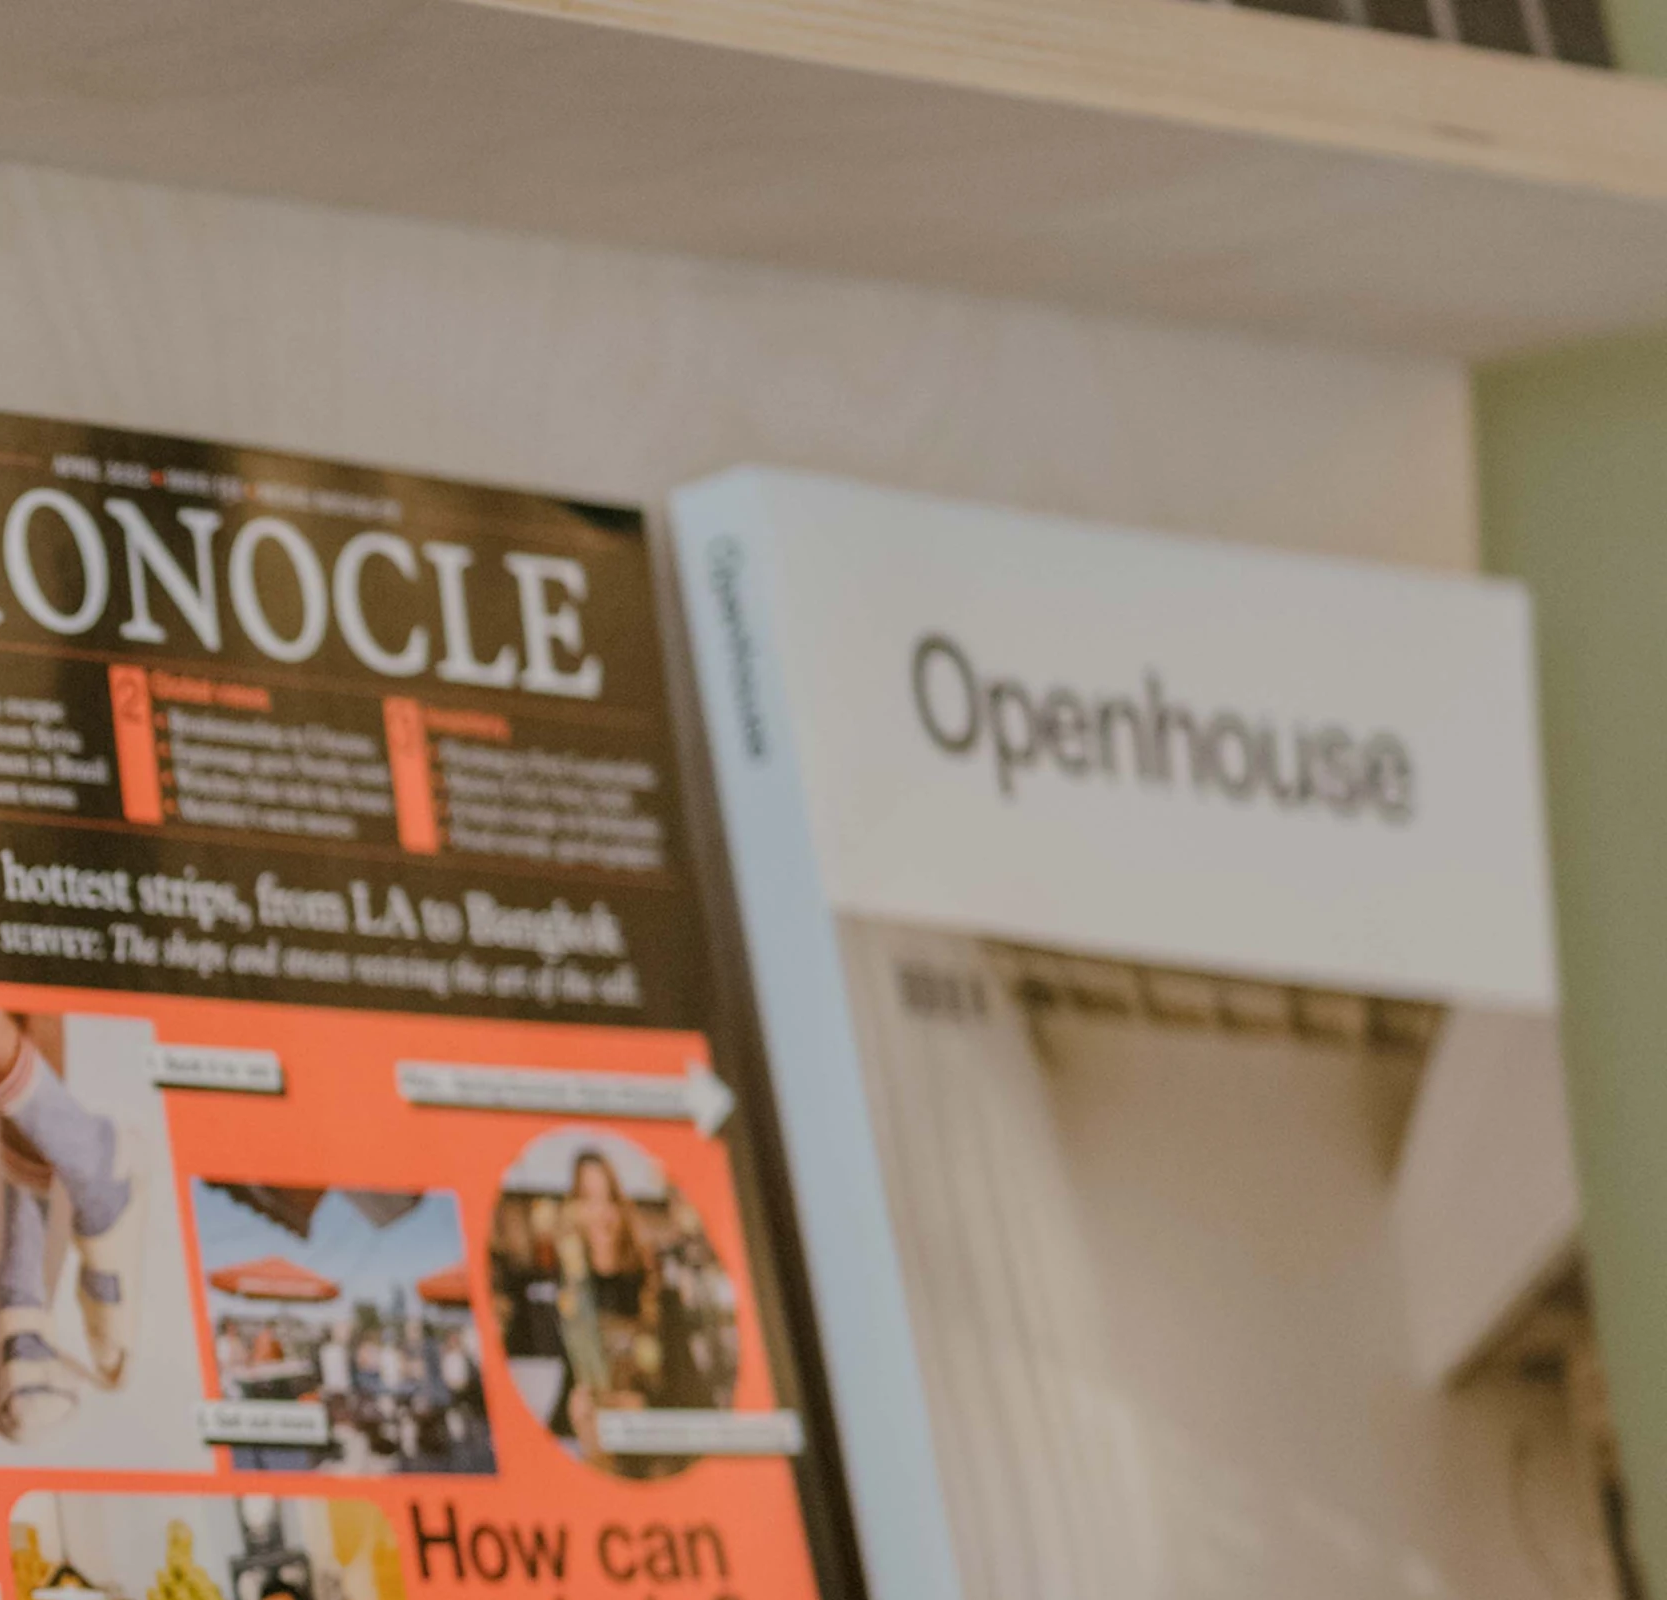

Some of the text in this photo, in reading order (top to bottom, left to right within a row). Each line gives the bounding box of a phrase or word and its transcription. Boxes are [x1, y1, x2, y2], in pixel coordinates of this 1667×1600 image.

[910, 630, 1414, 827] Openhouse
[0, 921, 106, 962] SURVEY:
[109, 921, 159, 966] The
[2, 850, 132, 912] hottest
[138, 866, 252, 931] strips,
[255, 872, 347, 931] from
[351, 880, 419, 940] LA
[422, 896, 463, 943] to
[467, 890, 625, 964] Bangkok
[409, 1501, 731, 1584] How can
